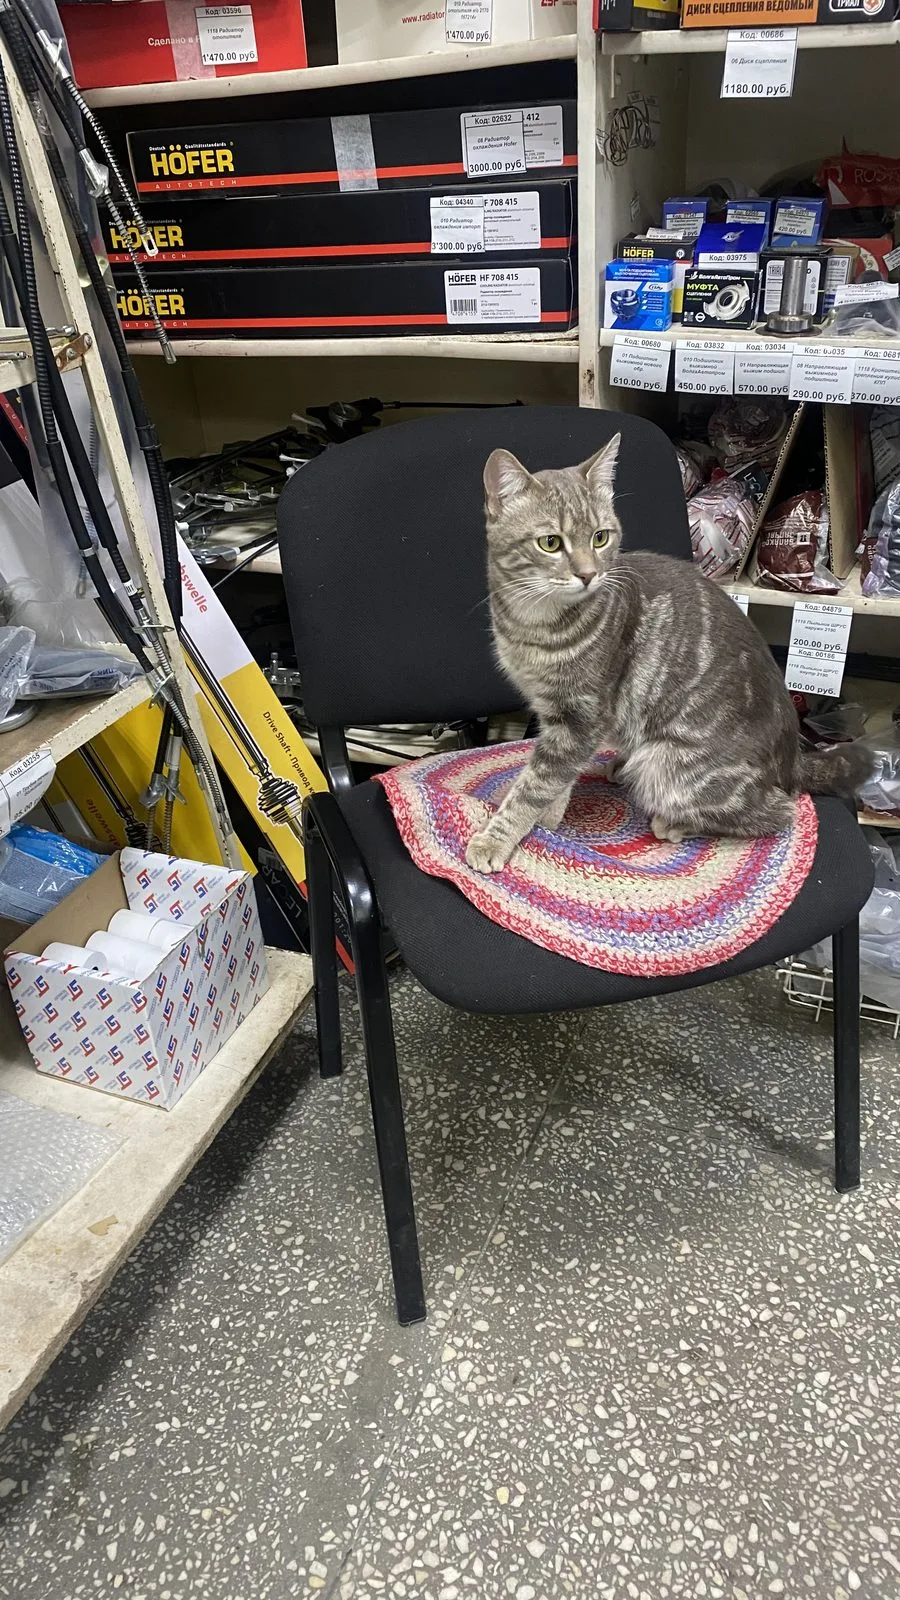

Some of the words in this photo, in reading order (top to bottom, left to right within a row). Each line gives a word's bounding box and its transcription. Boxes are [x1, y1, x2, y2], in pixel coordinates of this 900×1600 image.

[205, 8, 220, 16] Код:
[222, 7, 242, 15] 03596
[686, 4, 711, 16] ДИСК
[713, 1, 764, 14] СЦЕПЛЕНИЯ
[766, 0, 814, 12] ВЕДОМЫЙ
[446, 31, 475, 39] 1'470.00
[476, 31, 491, 42] руб.
[740, 31, 759, 39] Код:
[148, 36, 186, 46] Сделано
[202, 53, 237, 62] 1'470.00
[725, 84, 764, 94] 1180.00
[767, 84, 789, 96] руб.
[527, 113, 540, 121] 412
[150, 145, 235, 177] HÖFER
[470, 162, 502, 173] 3000.00
[505, 159, 525, 171] руб.
[505, 198, 518, 206] 415
[110, 220, 184, 249] HÖER
[432, 242, 465, 250] 3'300.00
[467, 242, 485, 252] руб.
[623, 247, 654, 258] HÖFER
[448, 273, 477, 283] HÖFER
[624, 338, 640, 346] Код:
[864, 350, 882, 358] Код:
[613, 377, 641, 386] 610.00
[644, 381, 663, 390] руб.
[678, 382, 707, 391] 450.00
[709, 384, 729, 393] руб.
[793, 390, 824, 400] 290.00
[826, 393, 847, 402] руб.
[793, 638, 822, 648] 200.00
[824, 643, 843, 652] руб.
[798, 649, 814, 657] Код:
[788, 682, 815, 692] 160.00
[817, 687, 836, 695] руб.
[263, 712, 278, 733] Drive
[276, 732, 291, 753] Shaft
[291, 757, 310, 788] Привод
[9, 766, 24, 778] Код:
[23, 752, 40, 768] 03255
